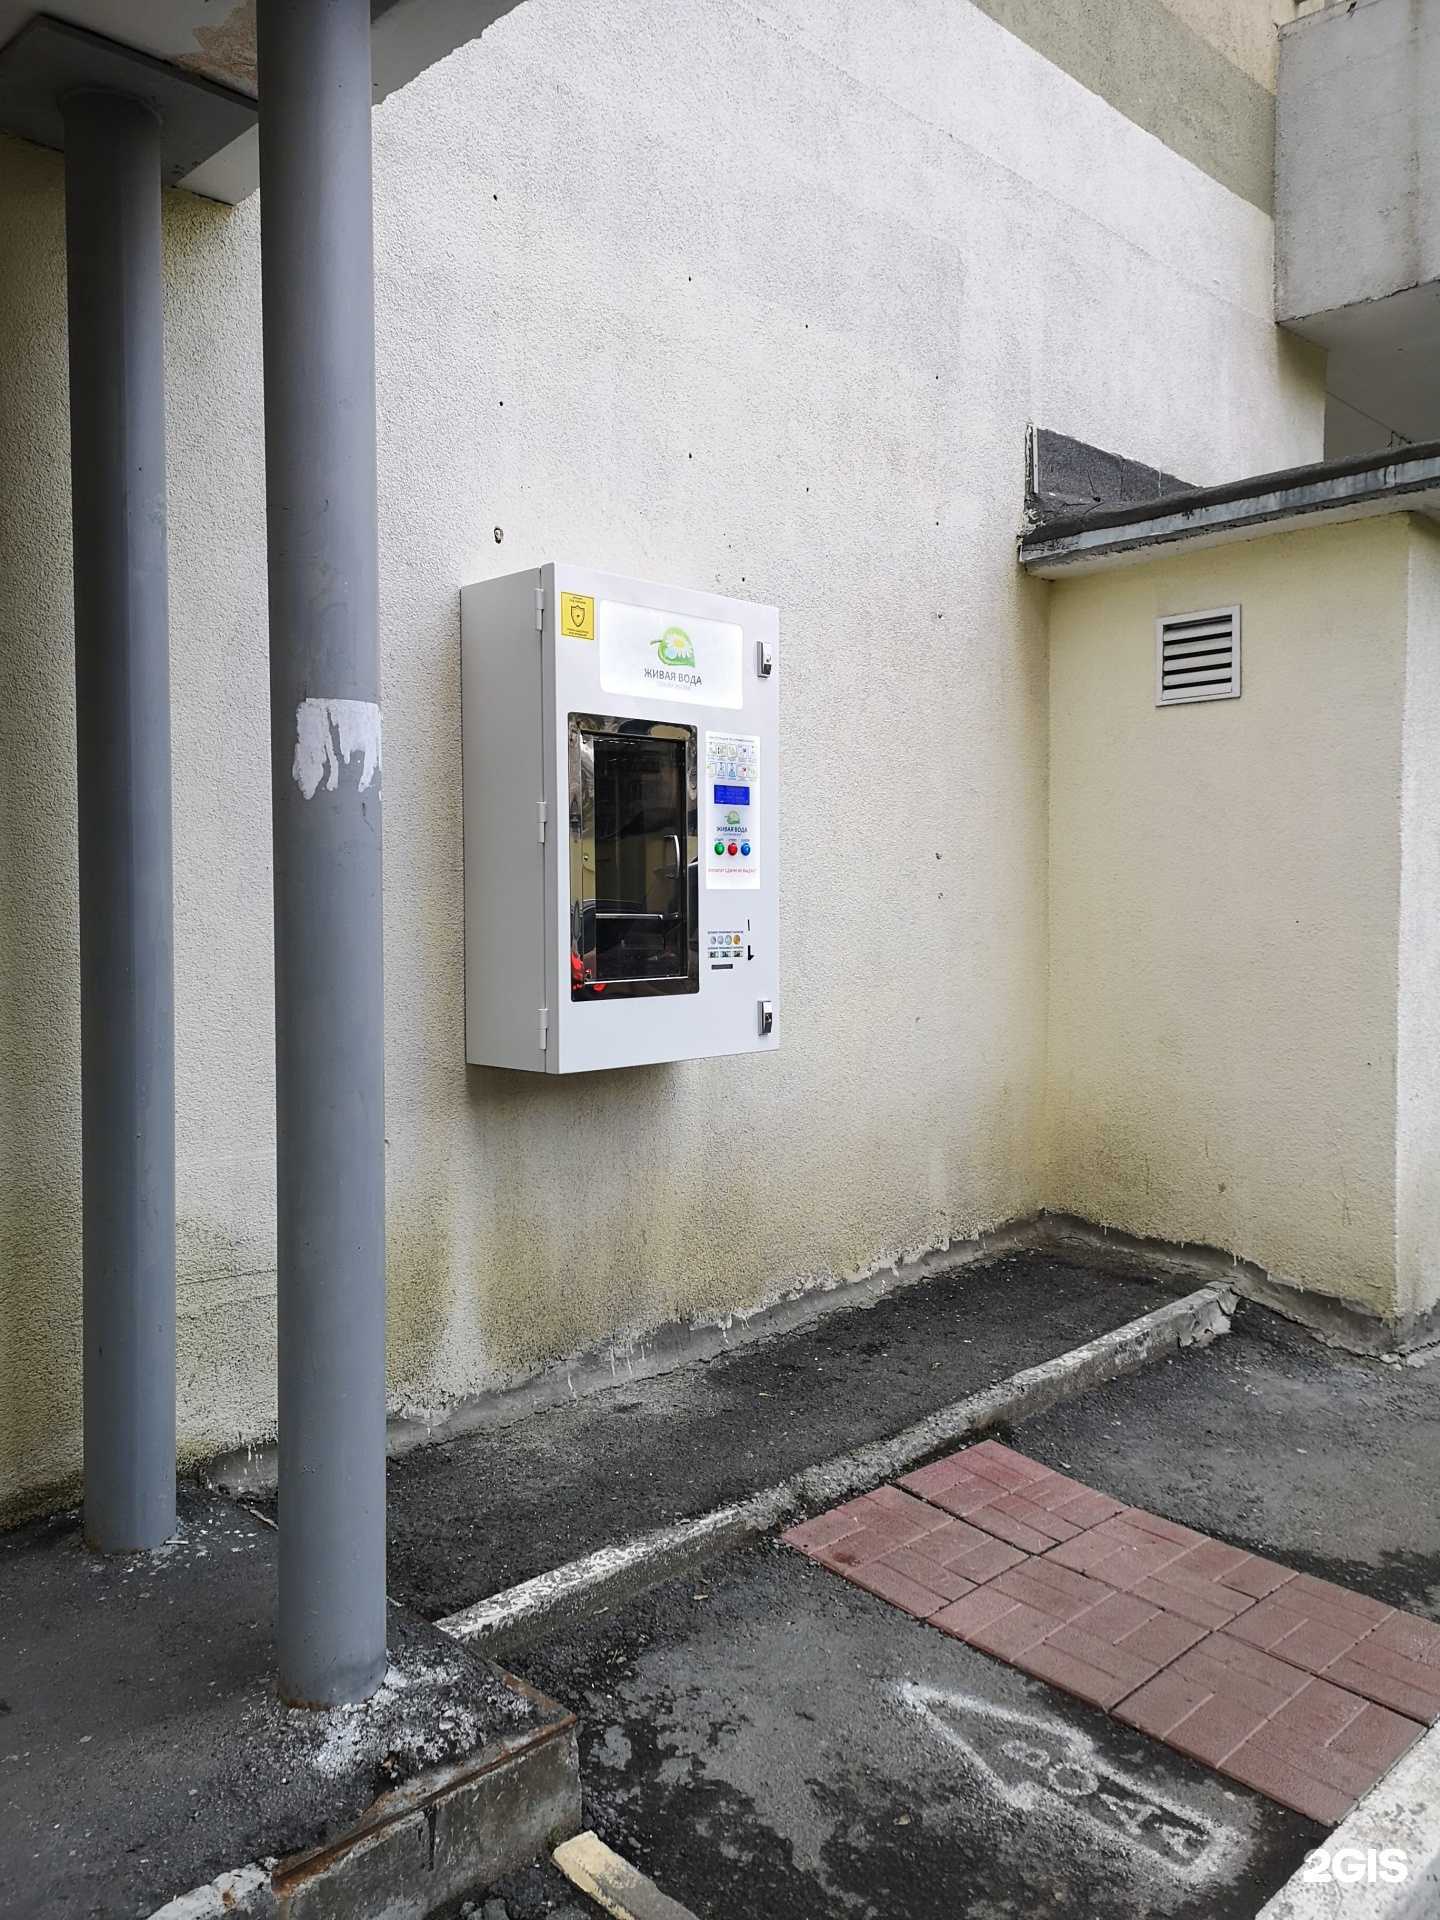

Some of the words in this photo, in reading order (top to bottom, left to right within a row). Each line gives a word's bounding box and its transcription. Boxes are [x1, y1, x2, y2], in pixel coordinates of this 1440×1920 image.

[643, 667, 676, 681] ЖИВАЯ
[678, 673, 703, 687] ВОДА
[1001, 1739, 1209, 1859] ВОДА
